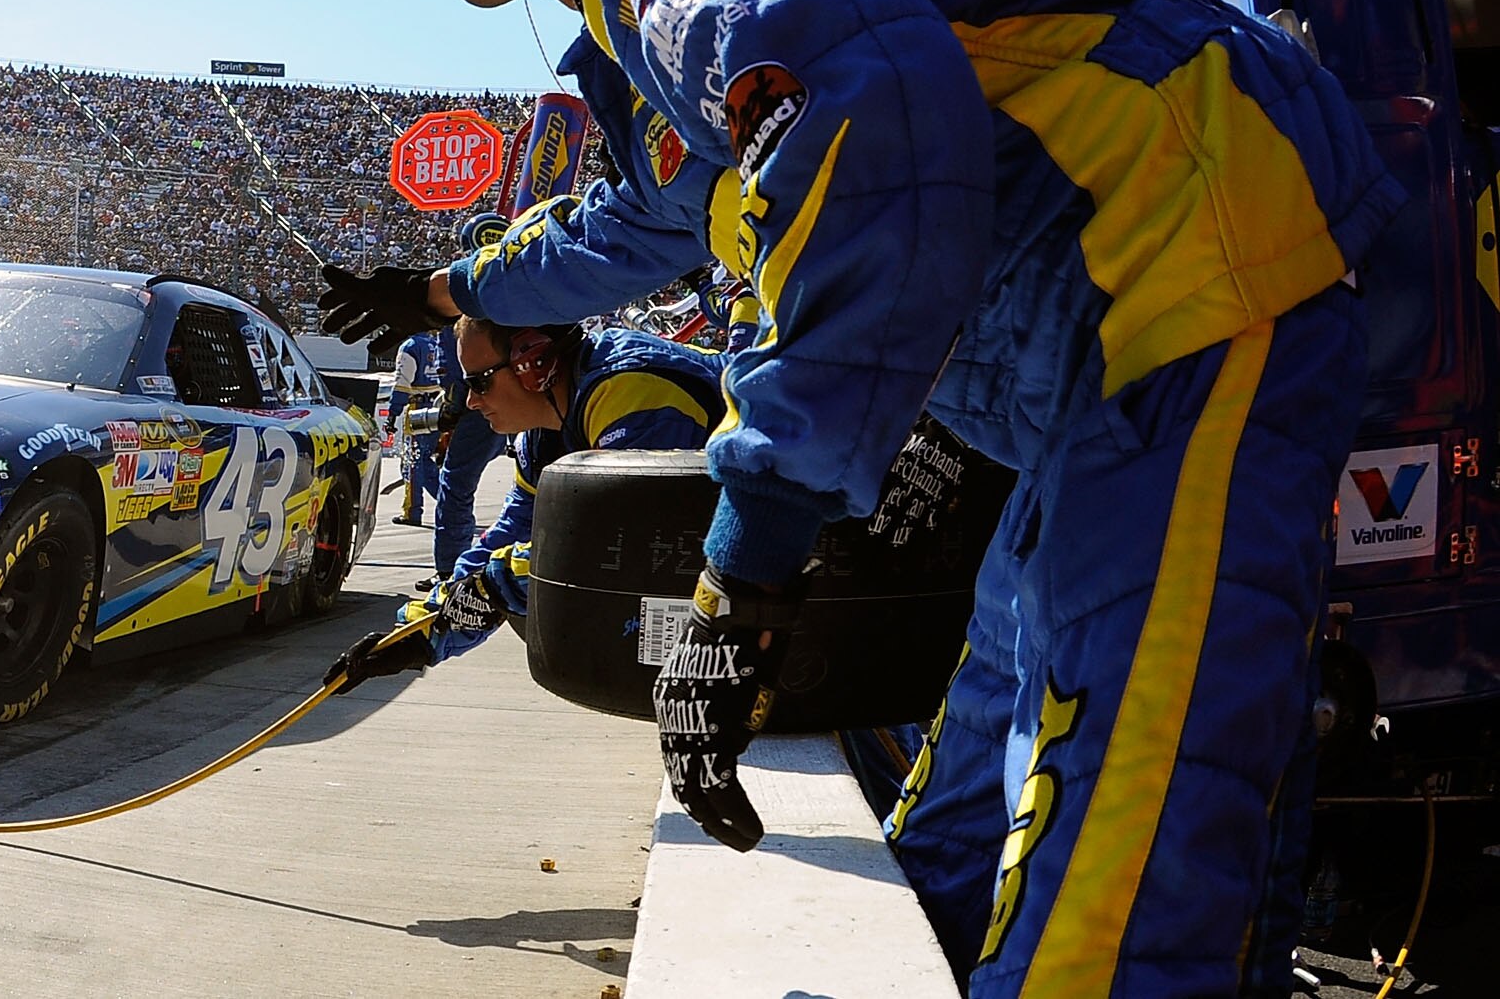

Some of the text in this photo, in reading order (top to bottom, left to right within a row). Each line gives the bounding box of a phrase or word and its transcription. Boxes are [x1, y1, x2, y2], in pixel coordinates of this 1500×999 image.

[214, 62, 282, 74] Sprint Tower
[413, 133, 481, 161] STOP
[531, 114, 565, 200] SUNOCO
[739, 97, 797, 183] squad
[416, 157, 477, 185] BEAK
[18, 423, 102, 460] GOODYEAR
[900, 433, 965, 485] Mechanix
[111, 453, 139, 488] 3M
[204, 425, 299, 584] 43
[1351, 524, 1426, 545] Valvoline
[442, 596, 484, 628] Mechanix
